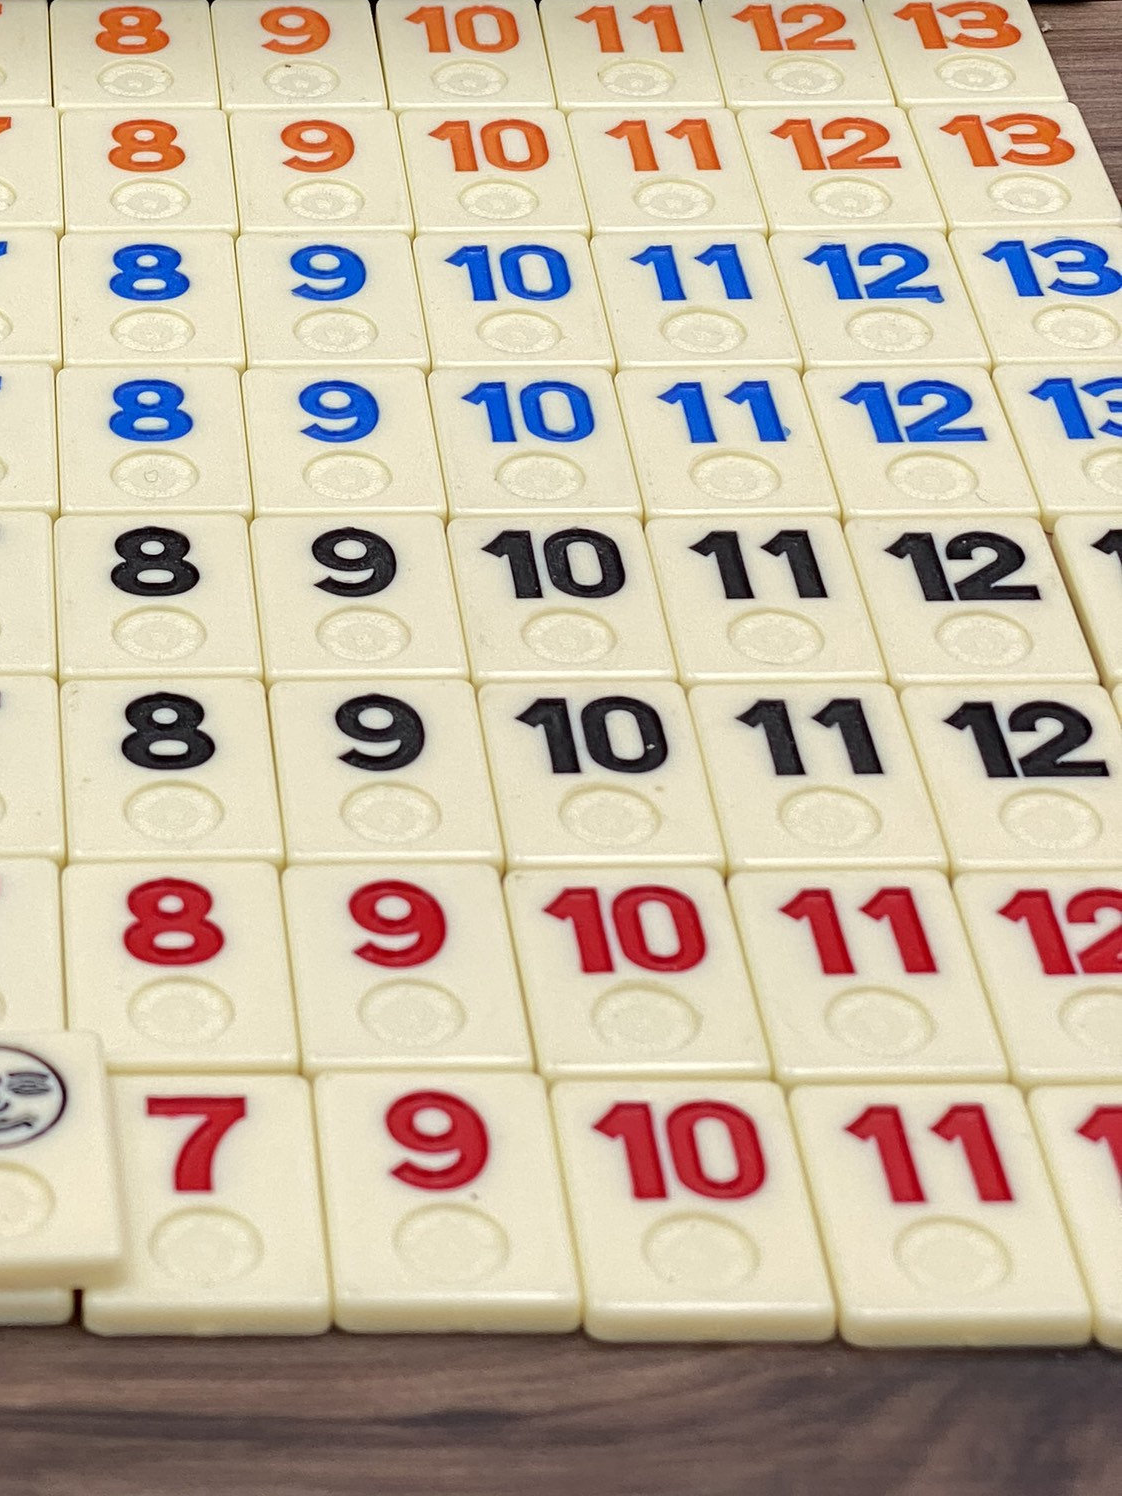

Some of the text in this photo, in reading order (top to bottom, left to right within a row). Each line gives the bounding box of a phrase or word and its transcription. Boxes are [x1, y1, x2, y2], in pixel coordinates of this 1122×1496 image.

[94, 6, 170, 54] 8
[260, 6, 330, 55] 9
[406, 5, 519, 53] 10
[575, 5, 684, 53] 11
[733, 4, 856, 51] 12
[894, 1, 1022, 49] 13
[108, 120, 186, 172] 8
[281, 120, 355, 172] 9
[429, 119, 549, 172] 10
[606, 119, 721, 171] 11
[771, 117, 901, 170] 12
[940, 113, 1075, 167] 13
[110, 244, 190, 301] 8
[290, 245, 366, 301] 9
[445, 245, 571, 301] 10
[632, 244, 751, 300] 11
[805, 243, 943, 303] 12
[983, 239, 1122, 296] 13
[109, 380, 193, 441] 8
[299, 381, 379, 442] 9
[462, 381, 594, 442] 10
[659, 381, 788, 443] 11
[841, 380, 986, 443] 12
[111, 526, 200, 596] 8
[312, 527, 396, 597] 9
[482, 528, 625, 598] 10
[689, 530, 828, 599] 11
[885, 531, 1041, 601] 12
[121, 692, 215, 770] 8
[335, 694, 425, 771] 9
[516, 696, 668, 773] 10
[736, 699, 884, 775] 11
[944, 701, 1109, 778] 12
[123, 878, 224, 965] 8
[349, 880, 446, 968] 9
[544, 886, 706, 973] 10
[780, 888, 937, 975] 11
[147, 1097, 246, 1192] 7
[386, 1091, 489, 1190] 9
[594, 1101, 766, 1200] 10
[846, 1105, 1013, 1203] 11
